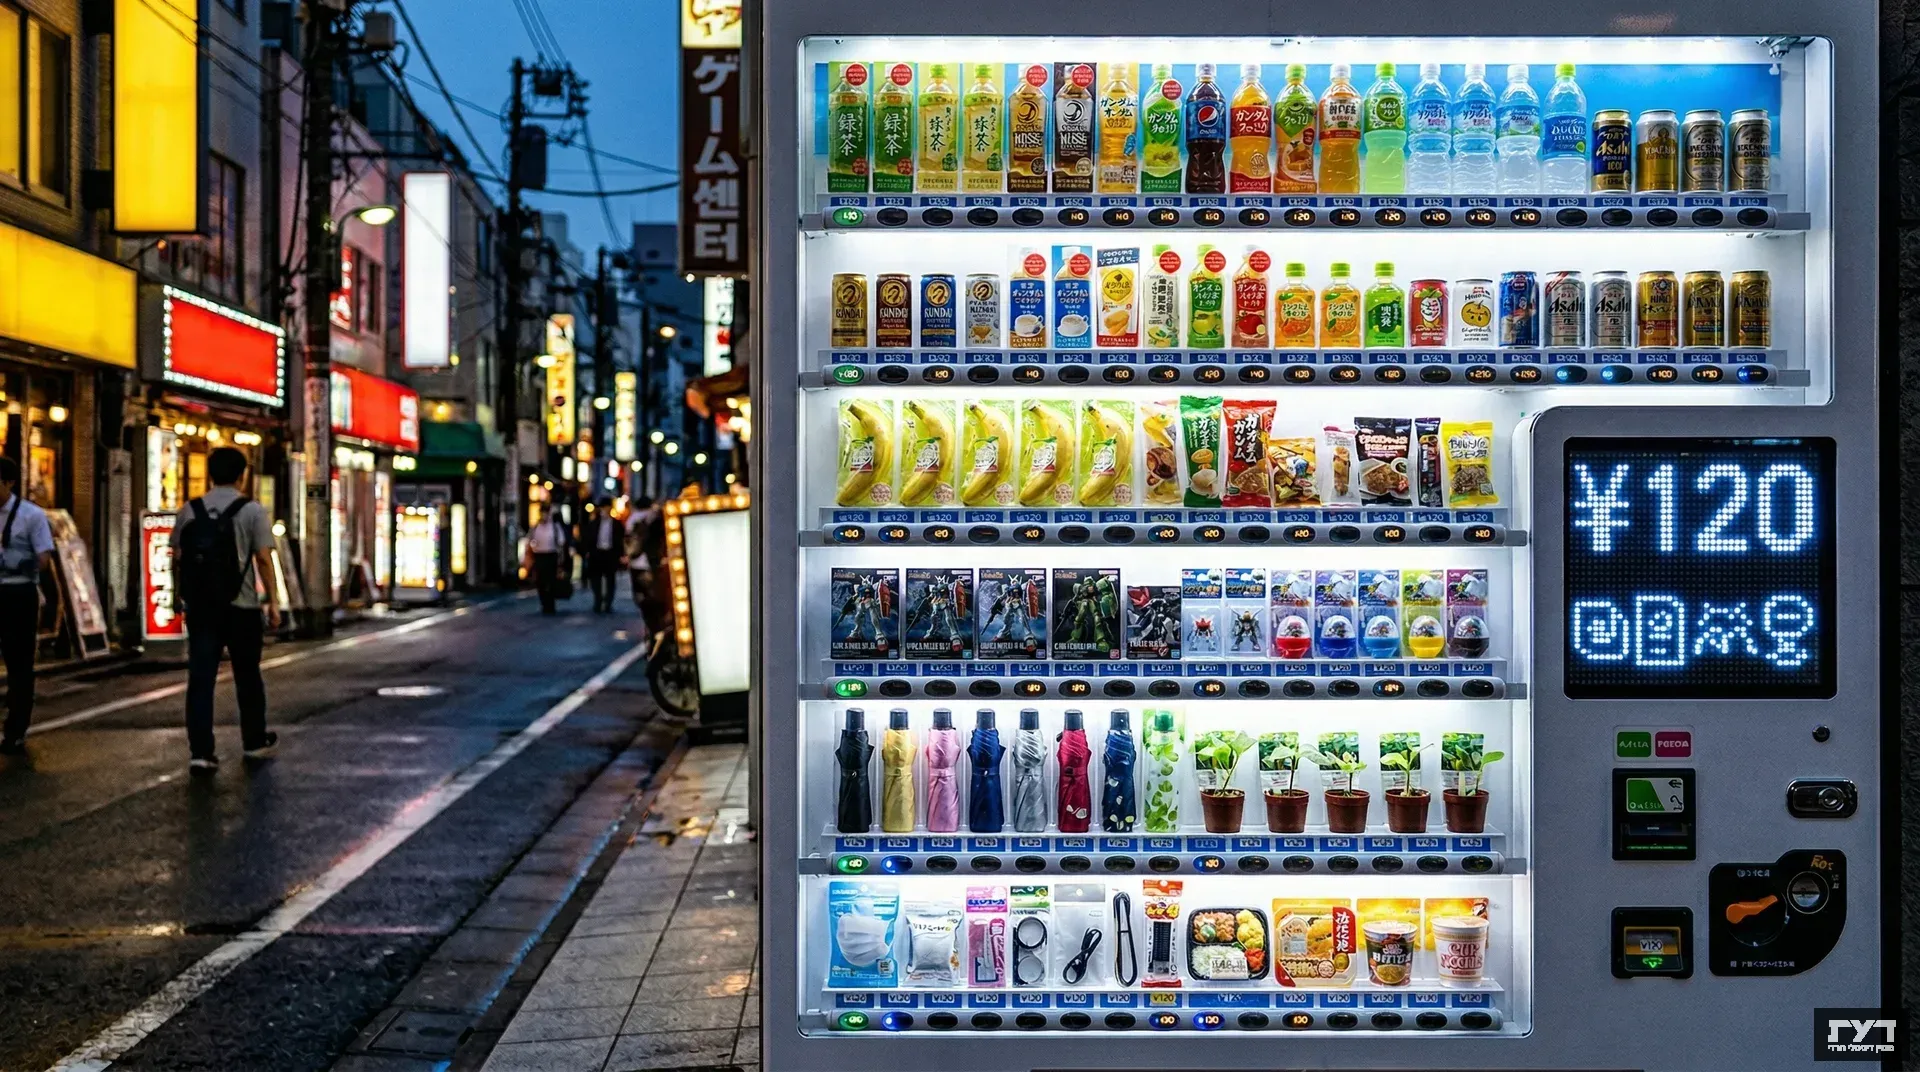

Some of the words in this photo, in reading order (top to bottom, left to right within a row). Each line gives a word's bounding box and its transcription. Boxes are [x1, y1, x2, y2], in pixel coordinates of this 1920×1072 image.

[838, 113, 857, 157] 緑茶
[883, 113, 903, 157] 緑茶
[1574, 464, 1814, 552] ¥120
